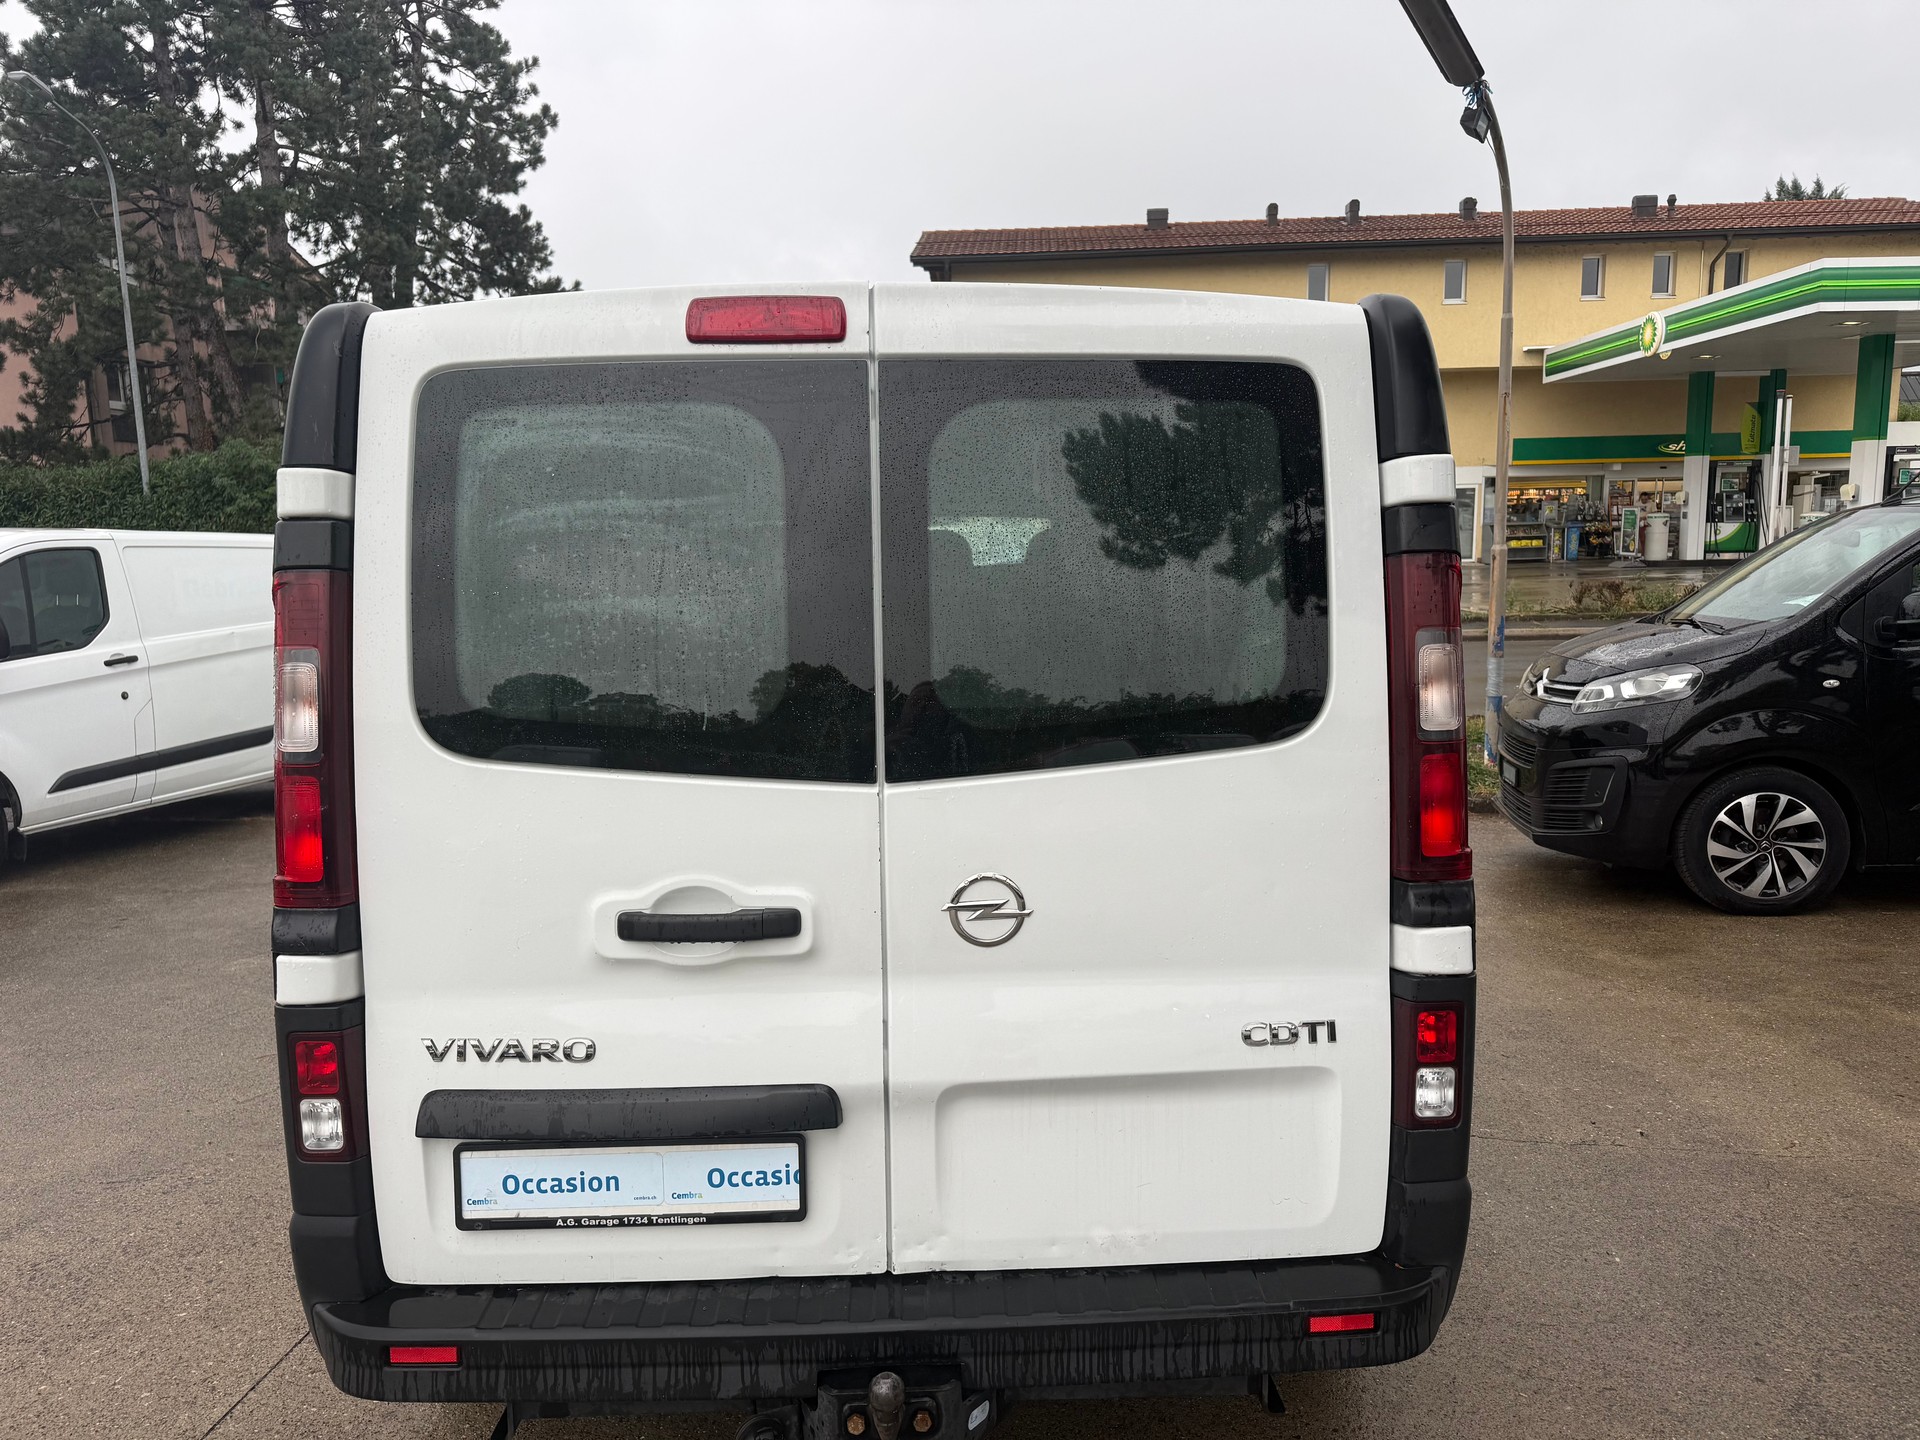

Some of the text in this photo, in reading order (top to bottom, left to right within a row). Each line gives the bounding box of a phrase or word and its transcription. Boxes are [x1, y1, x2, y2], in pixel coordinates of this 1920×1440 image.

[1241, 1019, 1338, 1047] CDTI
[420, 1037, 597, 1063] VIVARO
[501, 1171, 621, 1195] Occasion
[466, 1197, 498, 1206] Cembra
[671, 1191, 704, 1200] Cembra
[555, 1214, 707, 1227] A.G. Garage 1734 Tentlingen
